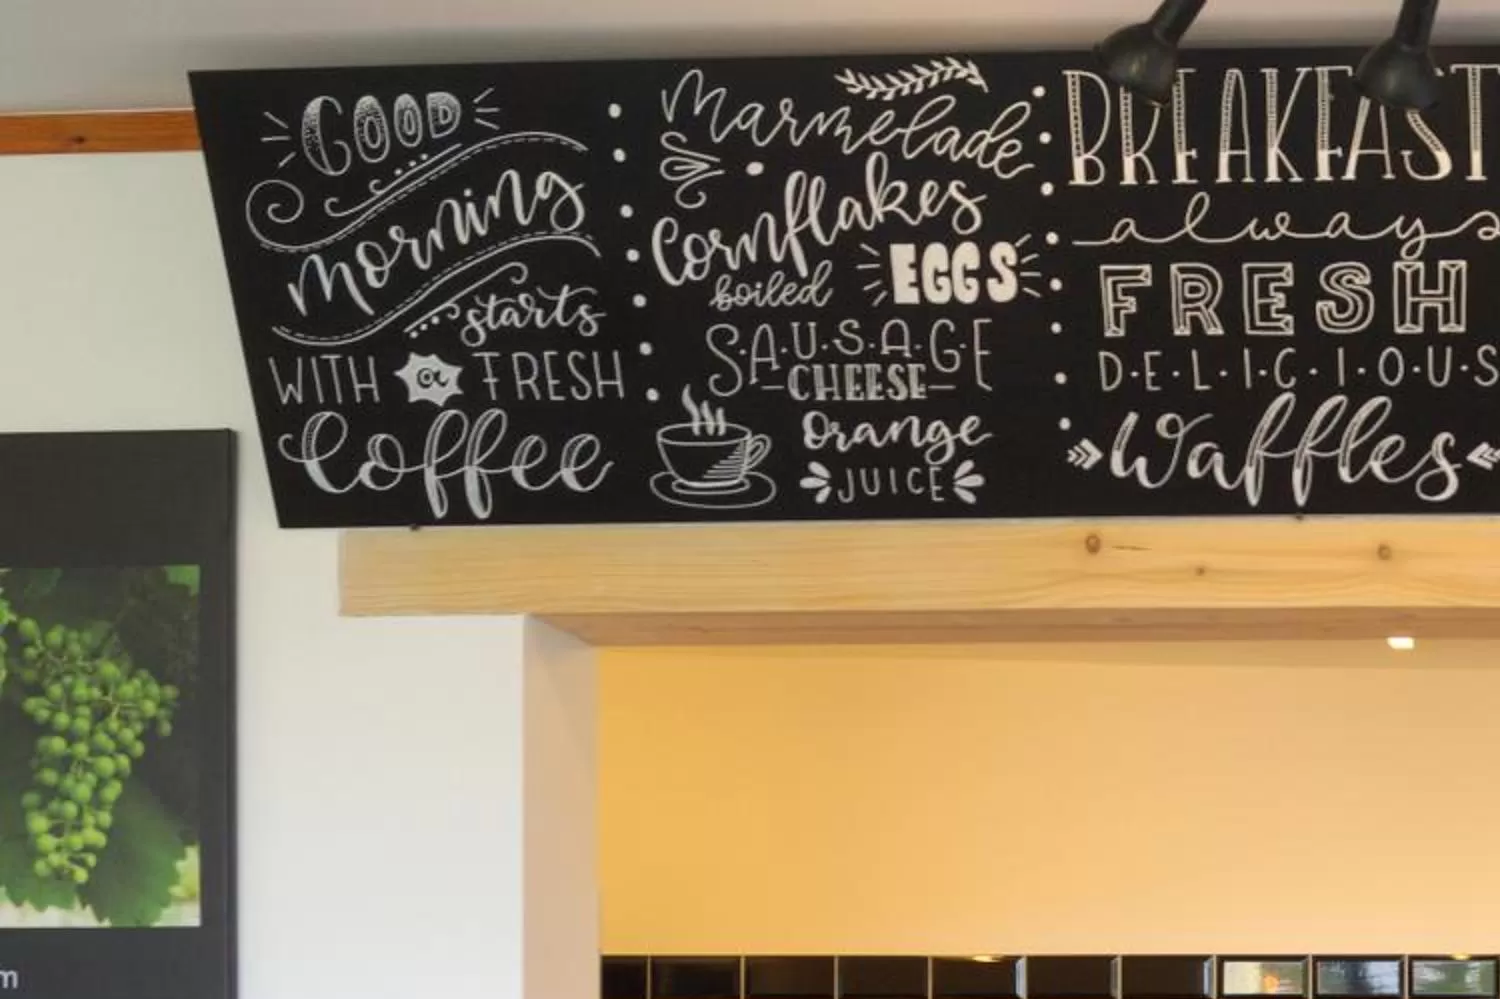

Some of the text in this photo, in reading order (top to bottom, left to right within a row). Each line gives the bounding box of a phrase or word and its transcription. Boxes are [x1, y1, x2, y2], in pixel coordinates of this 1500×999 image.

[302, 91, 461, 176] GOOD
[662, 69, 1035, 178] Marmelade
[652, 152, 987, 286] Cornflakes
[709, 241, 1019, 311] boiled EGGS
[1100, 260, 1467, 337] FRESH
[460, 284, 606, 347] starts
[269, 350, 624, 404] WITH a FRESH
[787, 363, 927, 401] CHEESE
[837, 468, 945, 502] JUICE
